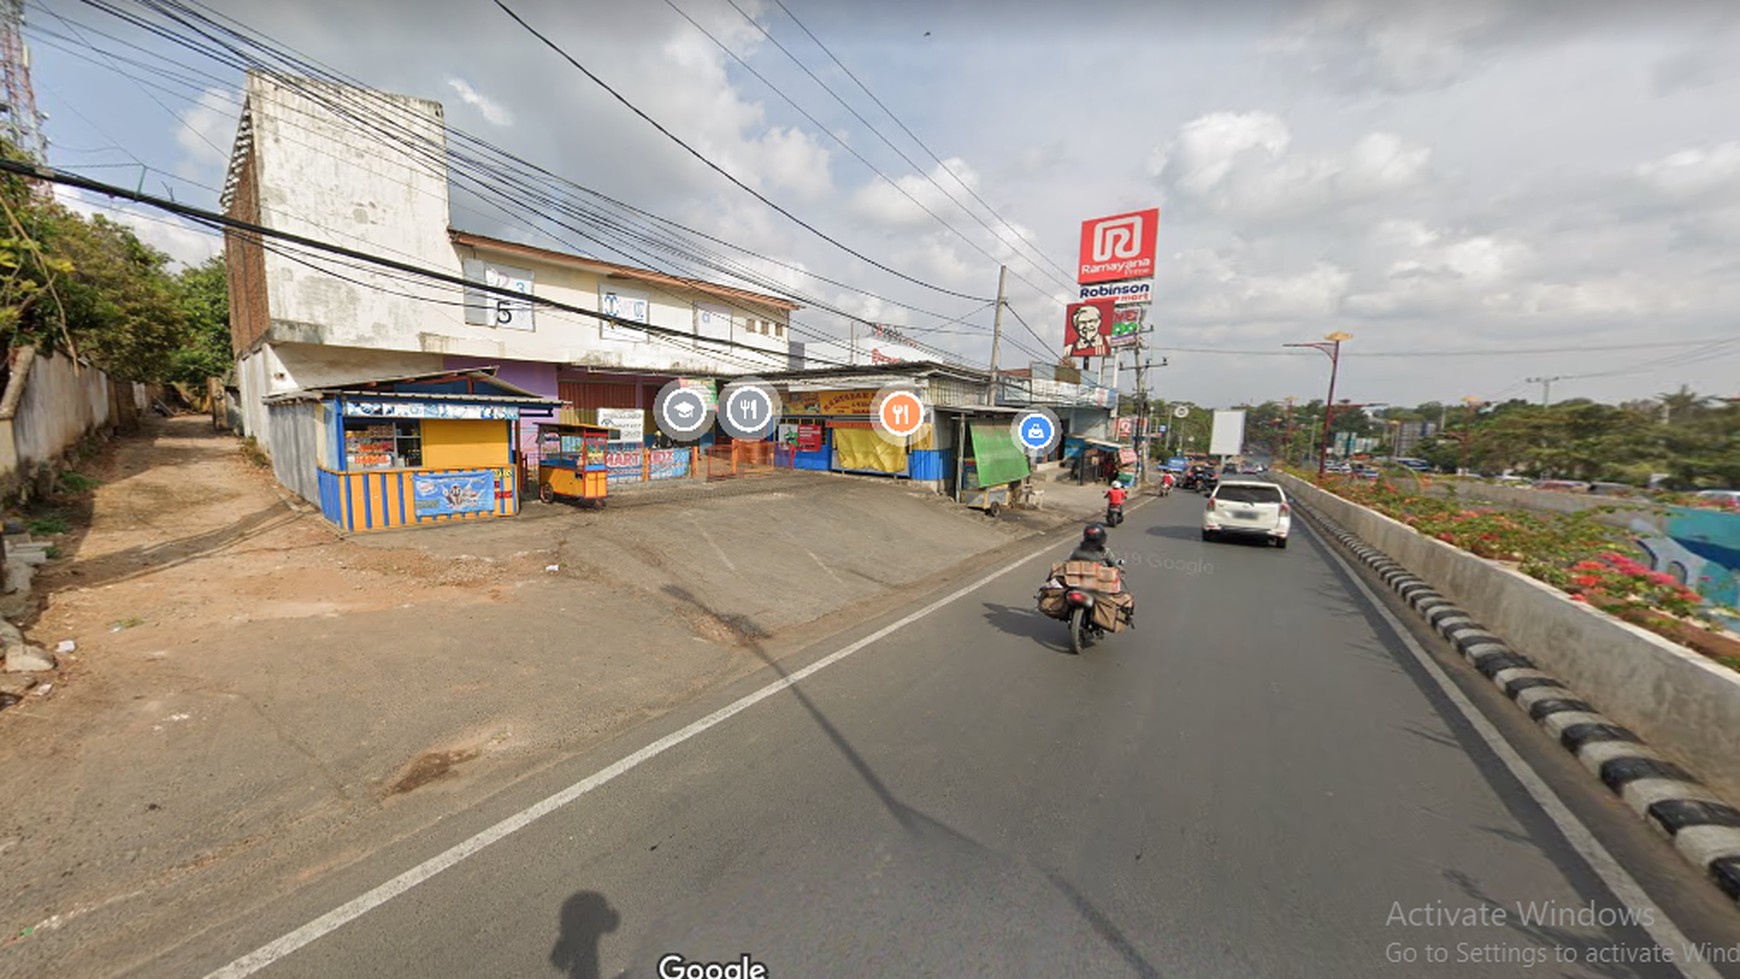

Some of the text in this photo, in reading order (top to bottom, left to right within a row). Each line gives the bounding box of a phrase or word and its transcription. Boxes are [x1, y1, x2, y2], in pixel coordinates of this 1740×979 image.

[1081, 258, 1150, 275] Ramayana
[1080, 283, 1150, 299] Robinson
[1120, 293, 1149, 302] mart
[497, 301, 512, 324] 5
